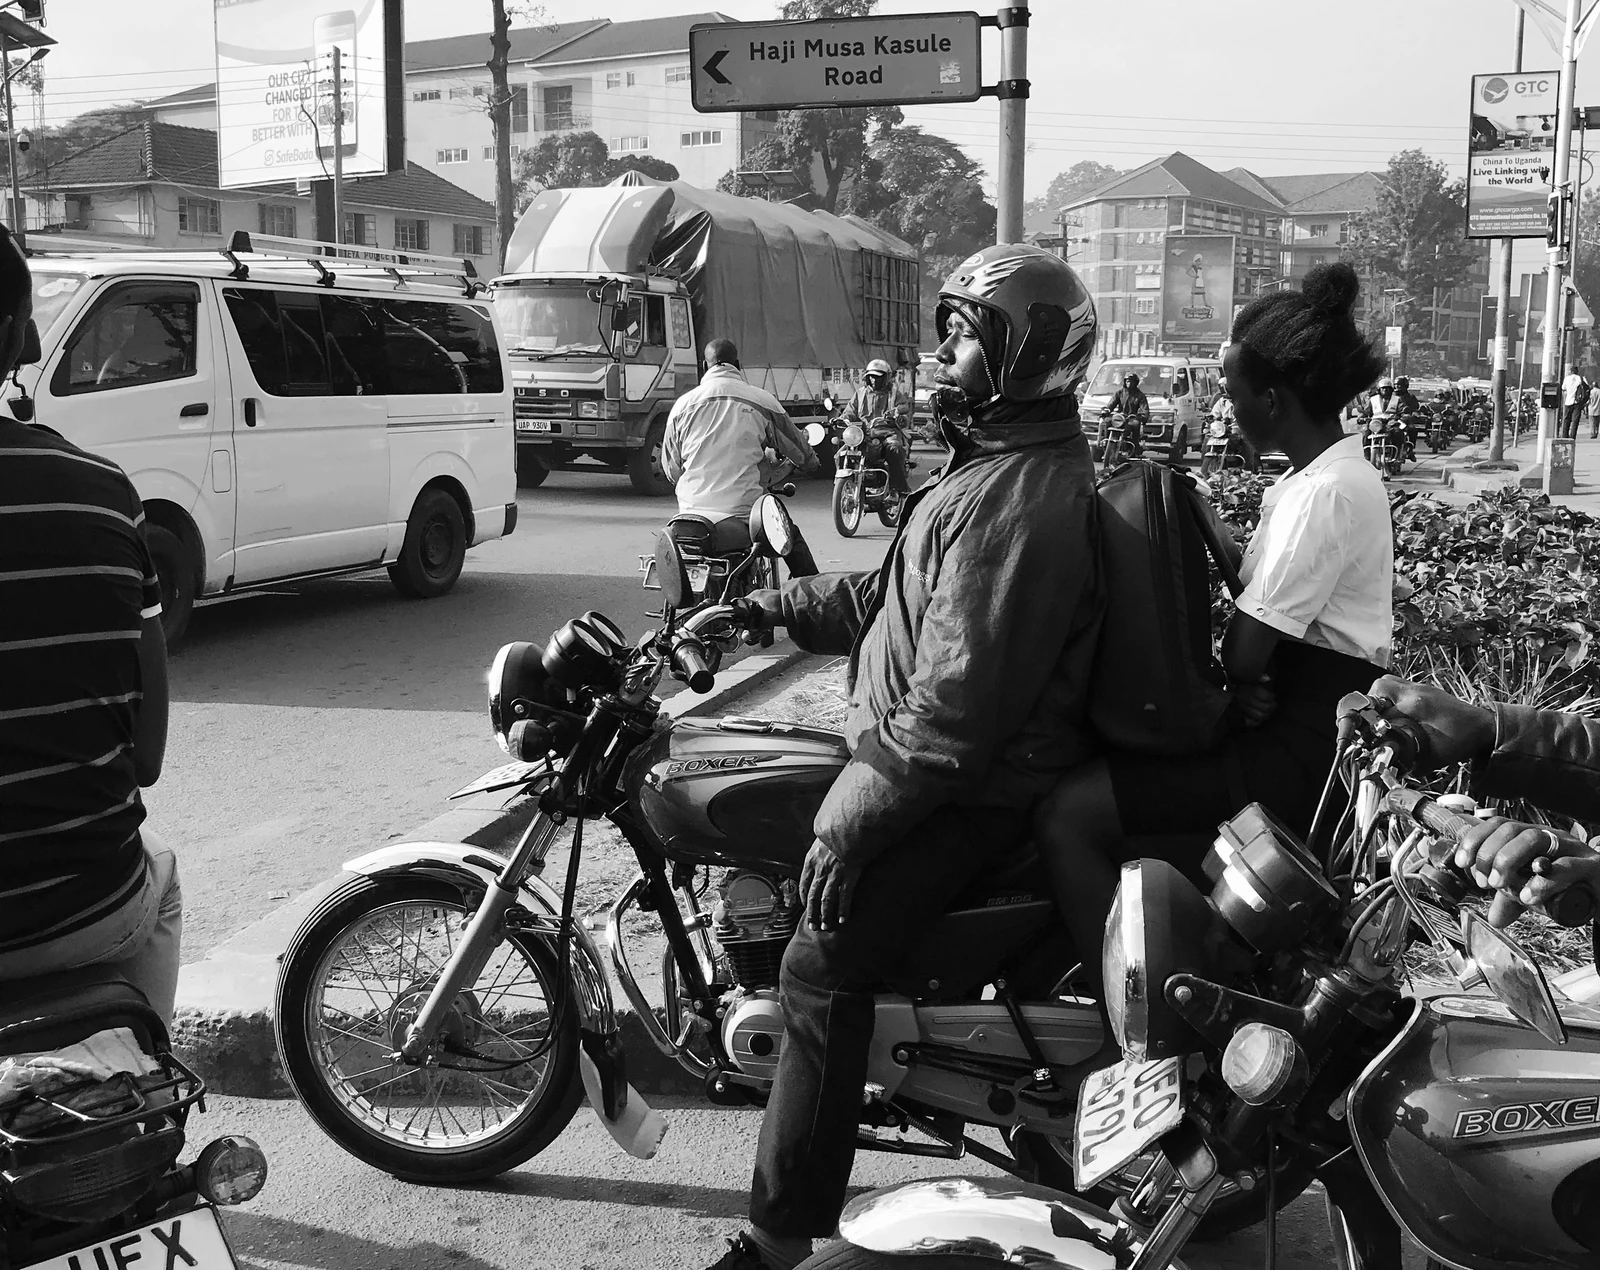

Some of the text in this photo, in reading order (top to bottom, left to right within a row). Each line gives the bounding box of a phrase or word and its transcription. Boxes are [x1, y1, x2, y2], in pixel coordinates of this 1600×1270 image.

[749, 33, 952, 63] Haji Musa Kasule
[268, 68, 312, 88] OUR CITY
[824, 65, 883, 86] Road
[1514, 80, 1550, 94] GTC
[265, 87, 312, 106] CHANGED
[273, 105, 313, 122] FOR THE
[252, 123, 313, 142] BETTER WITH
[276, 148, 314, 164] SafeBoda
[1482, 156, 1542, 166] China To Uganda
[1473, 166, 1550, 177] Live Linking with
[1505, 176, 1533, 185] World
[364, 251, 390, 261] POLCE
[517, 388, 570, 398] USO
[518, 421, 531, 430] UAP
[665, 754, 760, 776] BOXER
[1452, 1096, 1600, 1139] BOXE
